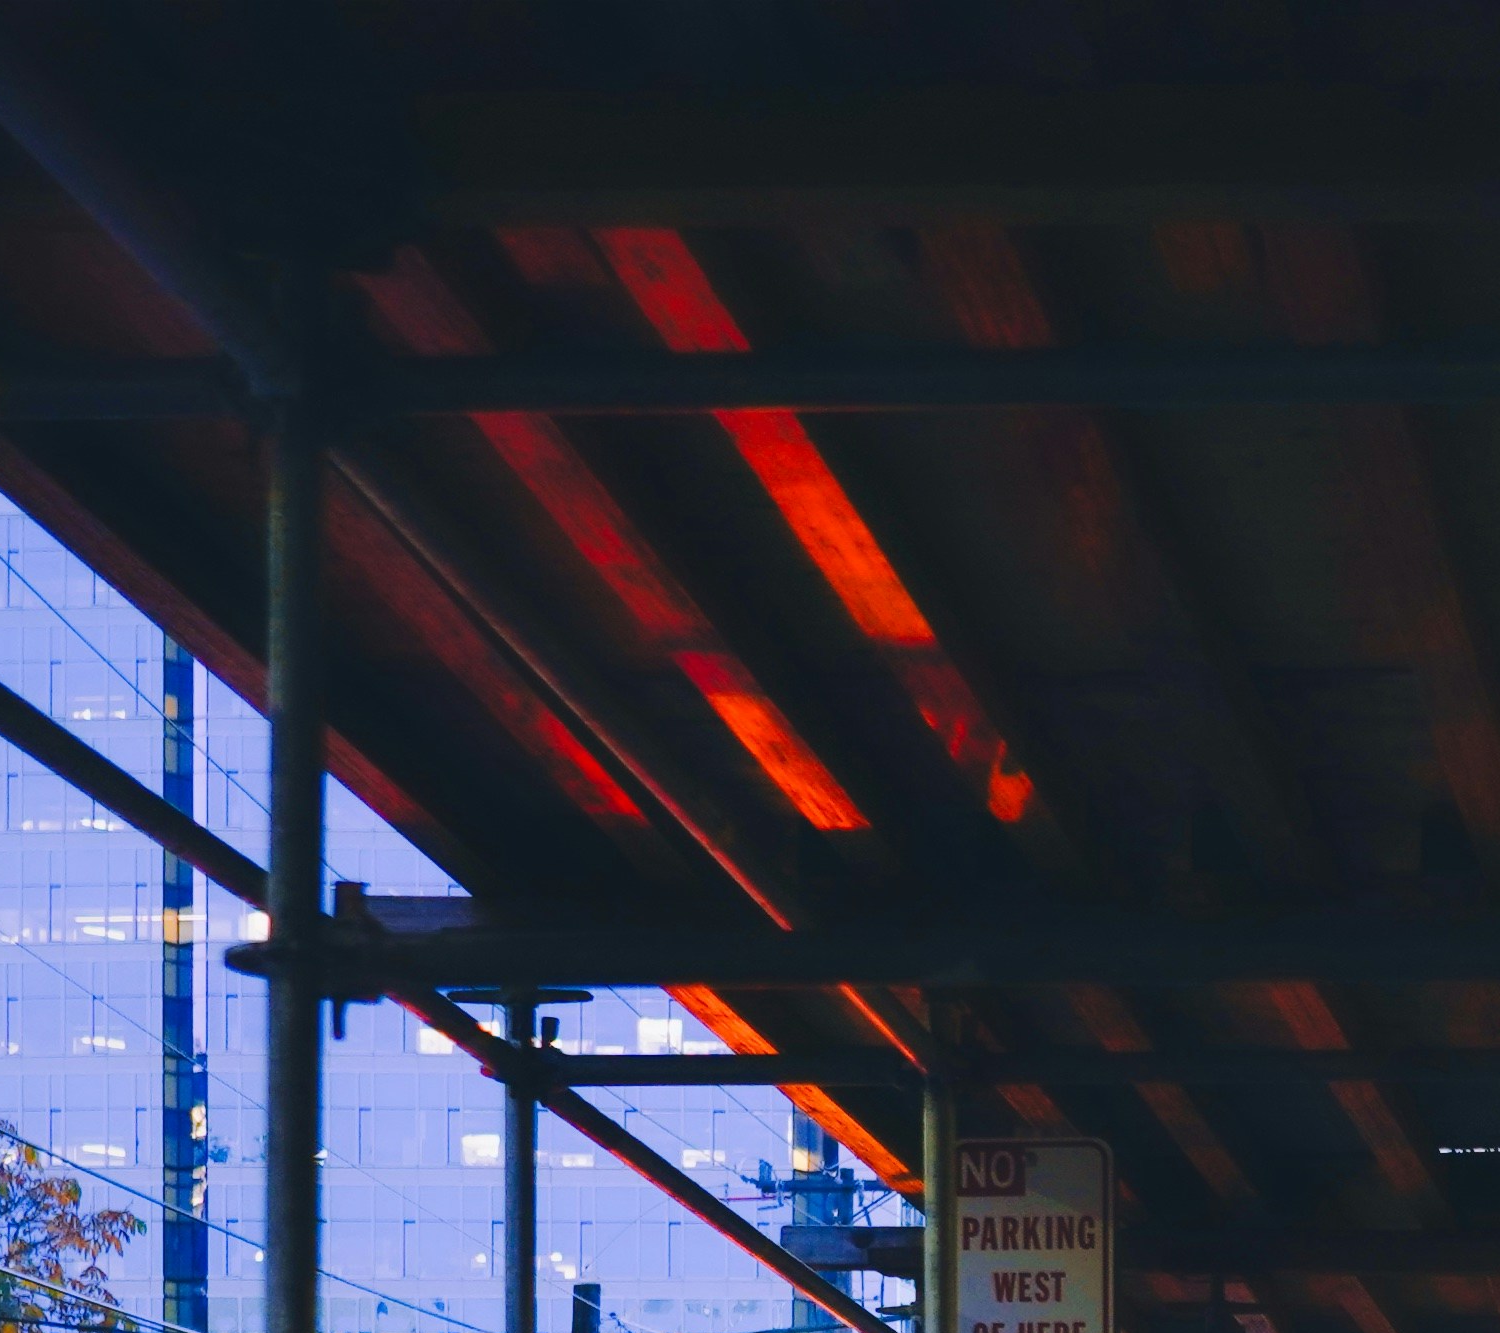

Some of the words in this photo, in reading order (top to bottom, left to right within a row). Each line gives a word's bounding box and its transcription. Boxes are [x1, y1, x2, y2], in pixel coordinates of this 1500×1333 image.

[960, 1150, 1016, 1189] NO
[961, 1215, 1096, 1251] PARKING
[993, 1271, 1067, 1303] WEST
